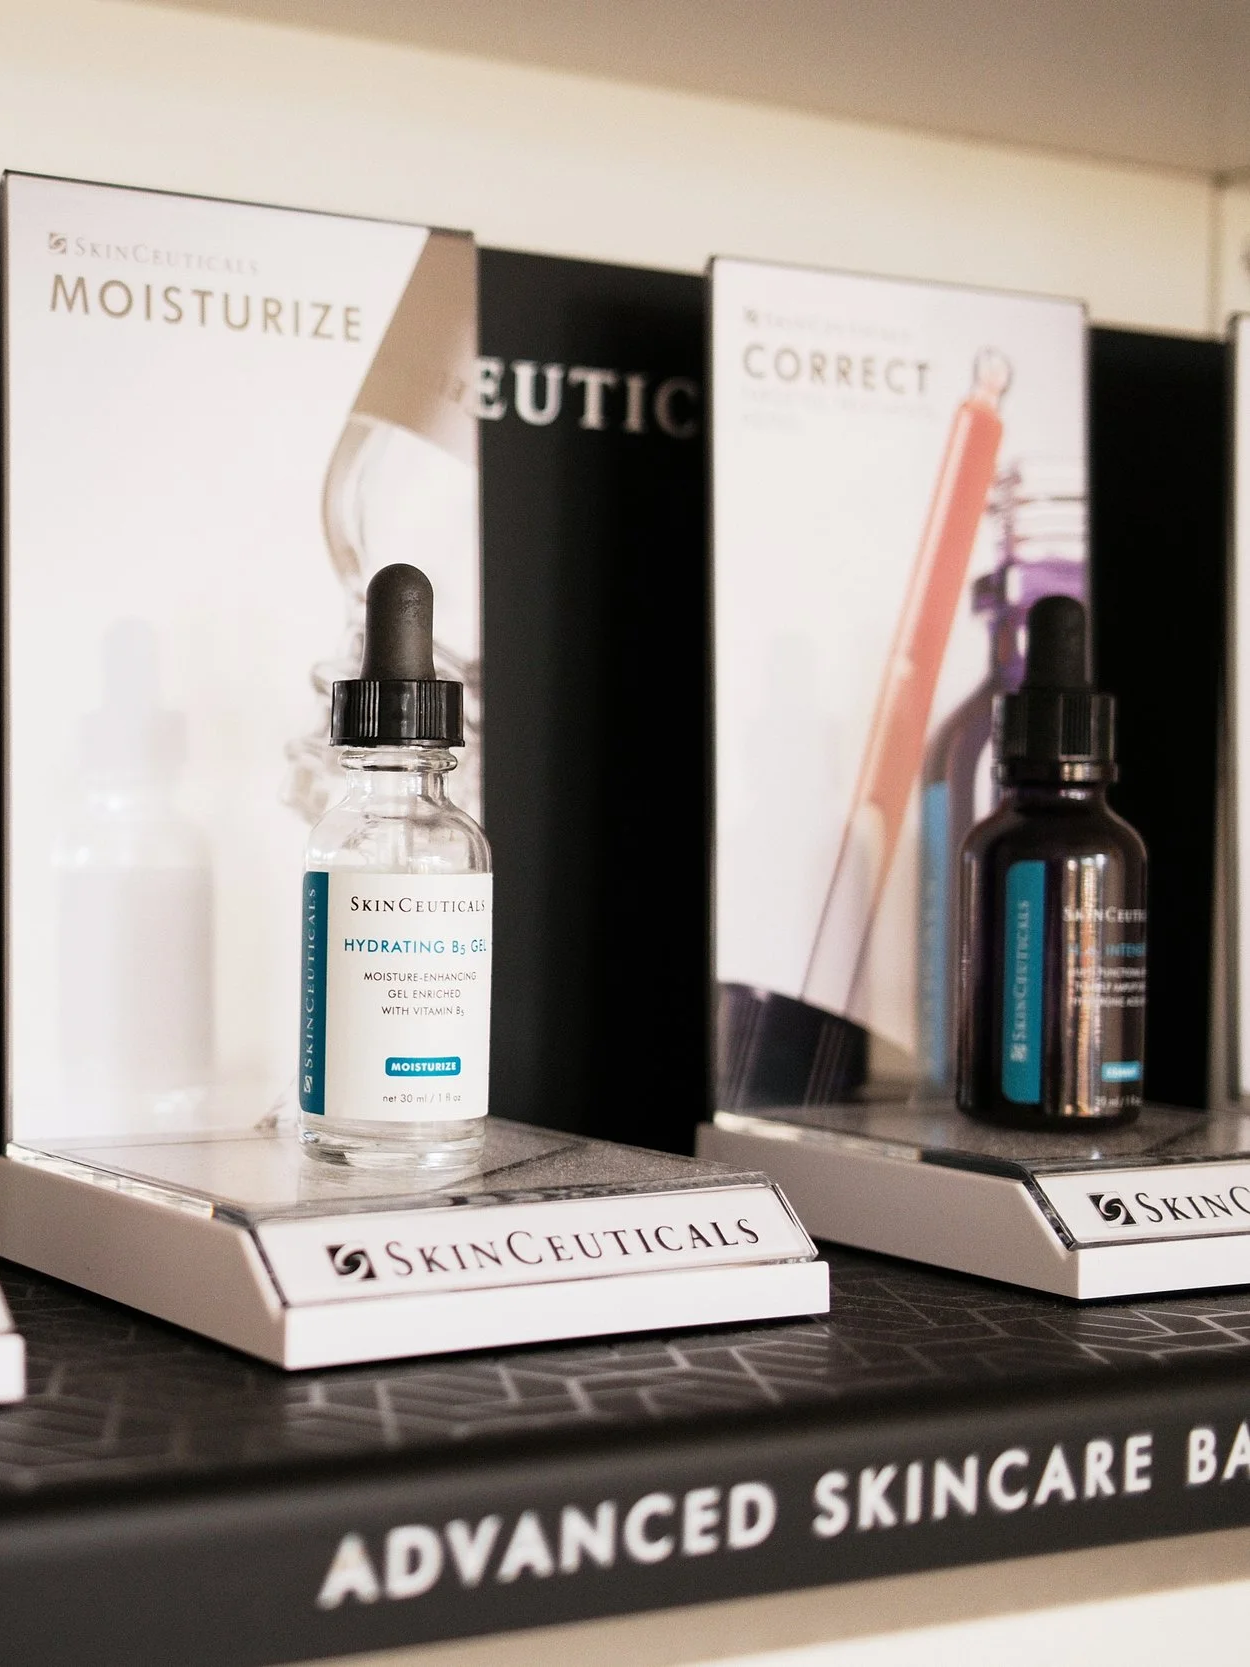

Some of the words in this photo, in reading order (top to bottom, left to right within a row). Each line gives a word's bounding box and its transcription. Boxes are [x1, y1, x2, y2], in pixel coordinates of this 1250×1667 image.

[49, 274, 363, 342] MOISTURIZE
[742, 341, 931, 396] CORRECT
[344, 939, 446, 954] HYDRATING
[470, 939, 488, 953] GEL
[363, 971, 477, 982] MOISTURE-ENHANCING
[387, 989, 409, 999] GEL
[412, 989, 461, 999] ENRICHED
[381, 1006, 410, 1016] WITH
[412, 1006, 454, 1017] VITAMIN
[390, 1061, 458, 1073] MOISTURIZE
[382, 1095, 398, 1103] net
[400, 1093, 414, 1103] 30
[416, 1094, 428, 1103] ml
[316, 1481, 778, 1611] ADVANCED
[812, 1433, 1153, 1538] SKINCARE
